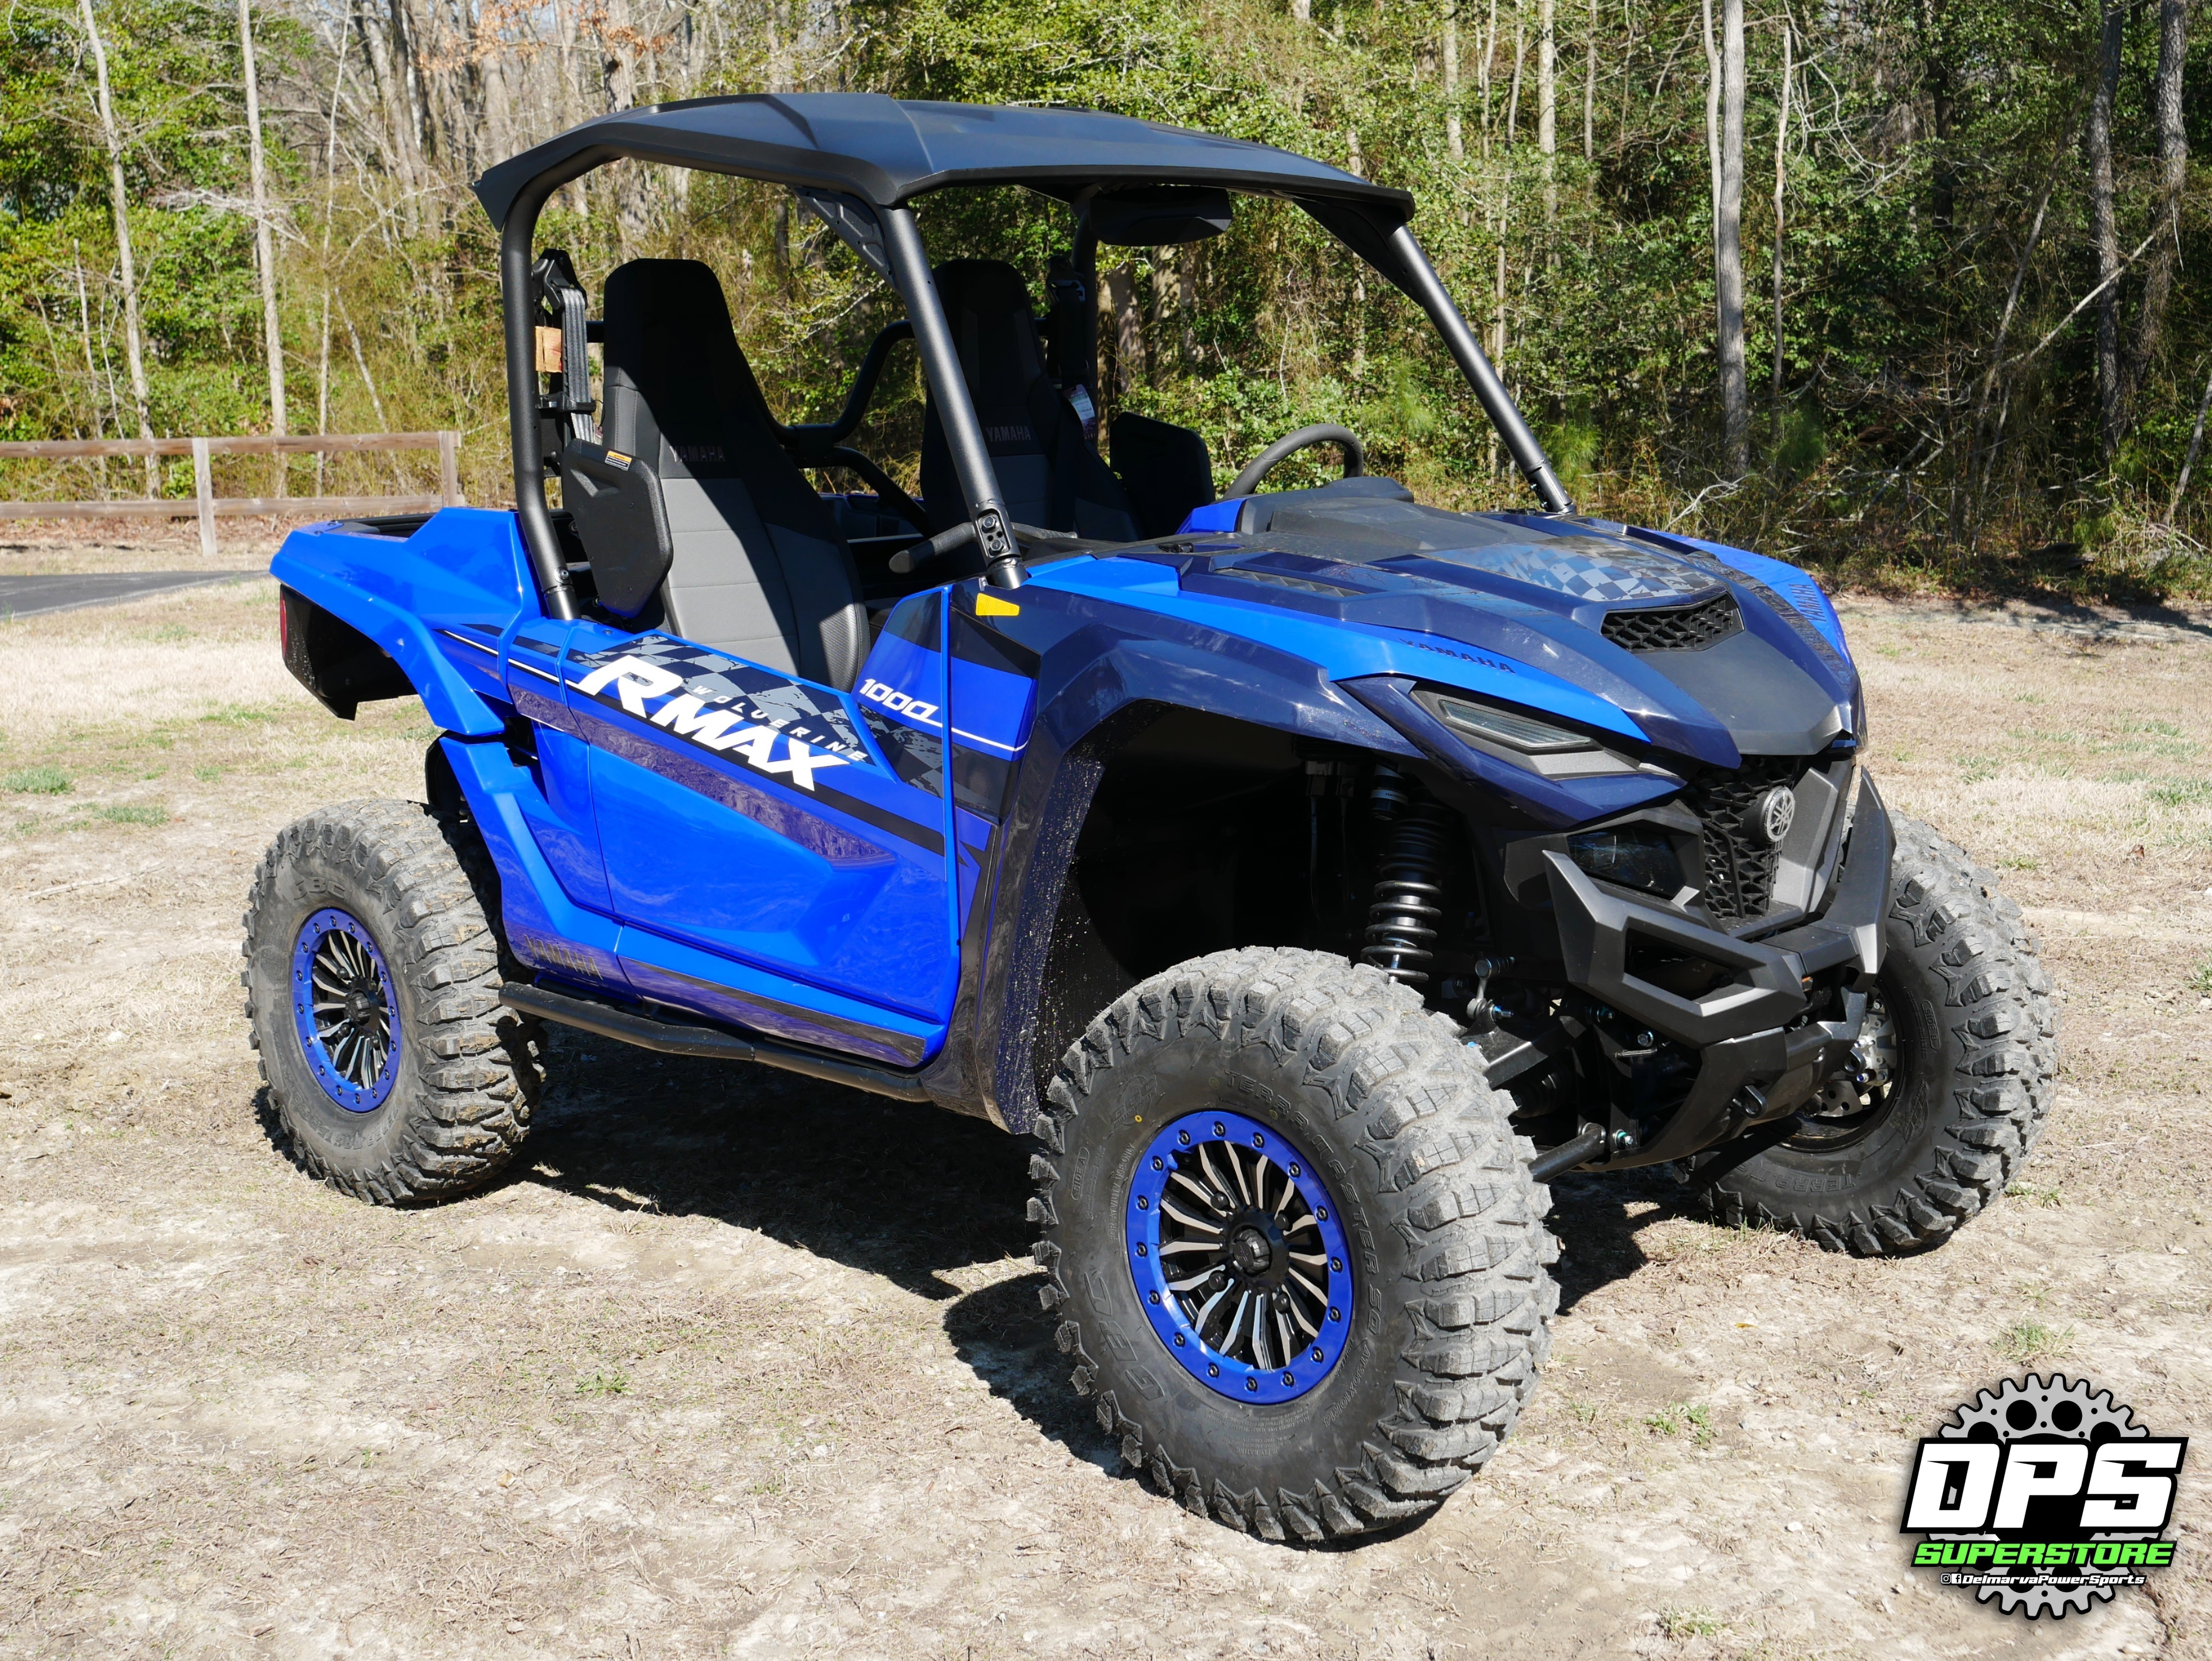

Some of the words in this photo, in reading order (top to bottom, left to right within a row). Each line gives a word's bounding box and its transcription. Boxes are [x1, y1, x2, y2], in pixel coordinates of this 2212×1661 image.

[986, 426, 1031, 442] YAMAHA
[669, 445, 725, 462] YAMAHA
[1398, 638, 1516, 674] YAMAHA
[859, 678, 939, 720] 1000
[576, 655, 852, 791] RMAX
[693, 685, 869, 762] WOLVERINE
[522, 934, 603, 980] YAMAHA
[1925, 1008, 1936, 1029] SIDE
[1224, 1069, 1309, 1132] TERRA
[1120, 1143, 1134, 1164] ONLY
[1073, 1167, 1084, 1191] SIDE
[1080, 1157, 1086, 1165] A
[1115, 1163, 1126, 1180] USE
[1776, 1173, 1856, 1193] TERRA
[1109, 1221, 1118, 1240] FOR
